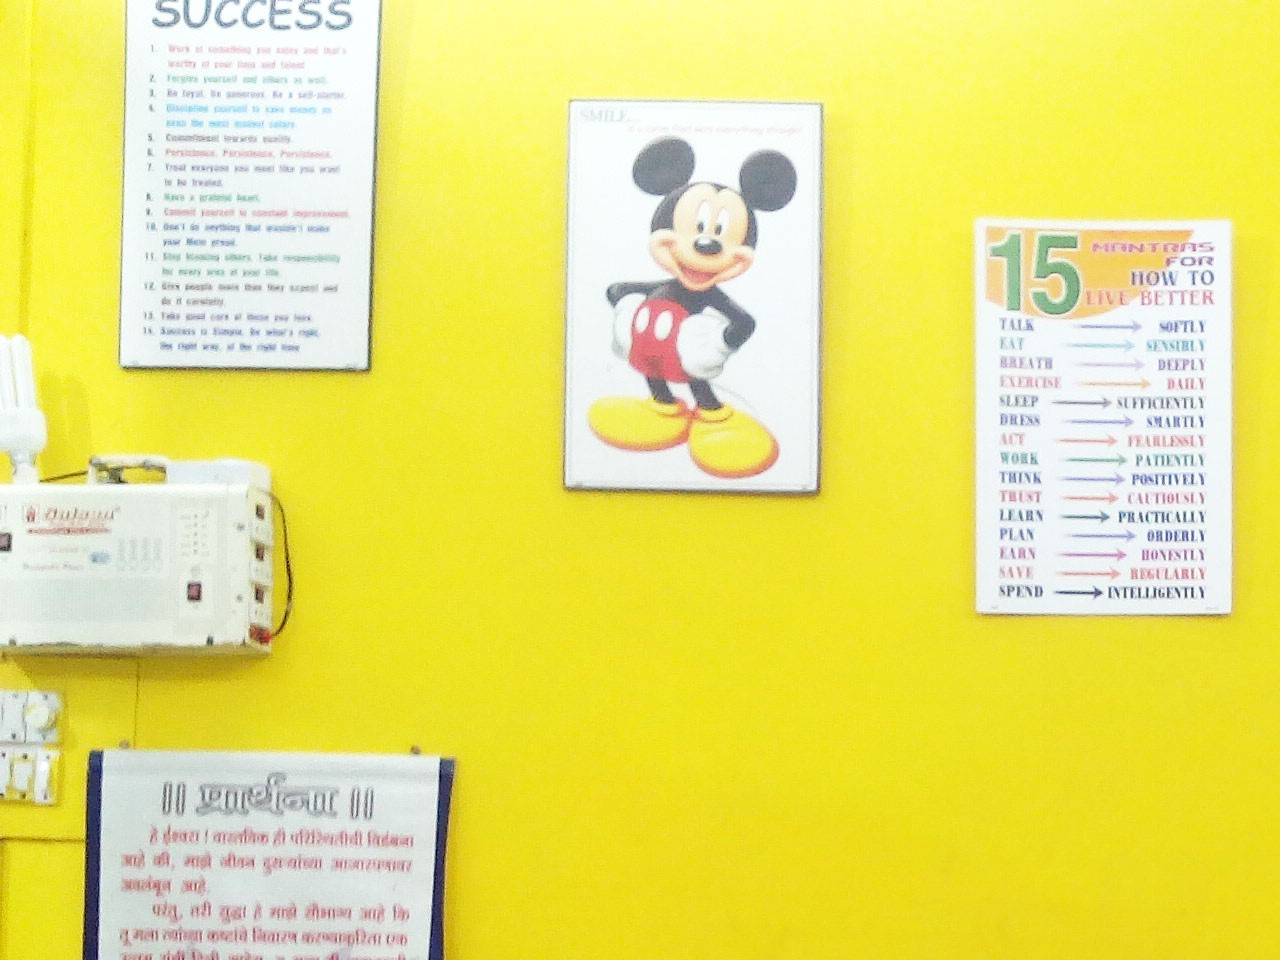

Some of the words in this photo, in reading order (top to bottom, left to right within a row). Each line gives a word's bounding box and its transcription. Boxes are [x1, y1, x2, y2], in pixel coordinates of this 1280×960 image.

[152, 0, 353, 30] SUCCESS
[1091, 242, 1215, 253] MANTRAS
[1165, 256, 1214, 267] FOR
[990, 232, 1081, 316] 15
[1130, 271, 1177, 286] HOW
[1191, 270, 1215, 285] TO
[1086, 290, 1128, 305] LIVE
[1140, 290, 1215, 305] BETTER
[1000, 318, 1035, 332] TALK
[1158, 320, 1206, 333] SOFTLY
[1000, 337, 1024, 350] EAT
[1146, 339, 1205, 352] SENSIBLY
[1000, 356, 1053, 369] BREATH
[1158, 359, 1206, 371] DEEPLY
[1000, 376, 1062, 388] EXERCISE
[1167, 378, 1205, 390] DAILY
[1000, 395, 1039, 408] SLEEP
[1117, 397, 1206, 409] SUFFICIENTLY
[1000, 414, 1041, 427] DRESS
[1146, 416, 1206, 428] SMARTLY
[1000, 433, 1026, 445] ACT
[1127, 435, 1206, 447] FEARLESSLY
[1000, 452, 1039, 465] WORK
[1135, 454, 1206, 467] PATIENTLY
[1000, 471, 1042, 484] THINK
[1132, 473, 1207, 486] POSITIVELY
[1000, 490, 1042, 503] TRUST
[1127, 492, 1206, 505] CAUTIOUSLY
[999, 509, 1044, 522] LEARN
[1118, 511, 1207, 524] PRACTICALLY
[1000, 528, 1035, 541] PLAN
[1147, 530, 1207, 542] ORDERLY
[1000, 547, 1036, 560] EARN
[1141, 549, 1206, 561] HONESTLY
[1000, 567, 1033, 579] SAVE
[1130, 568, 1207, 580] REGULARLY
[999, 585, 1044, 598] SPEND
[1108, 586, 1207, 600] INTELLIGENTLY
